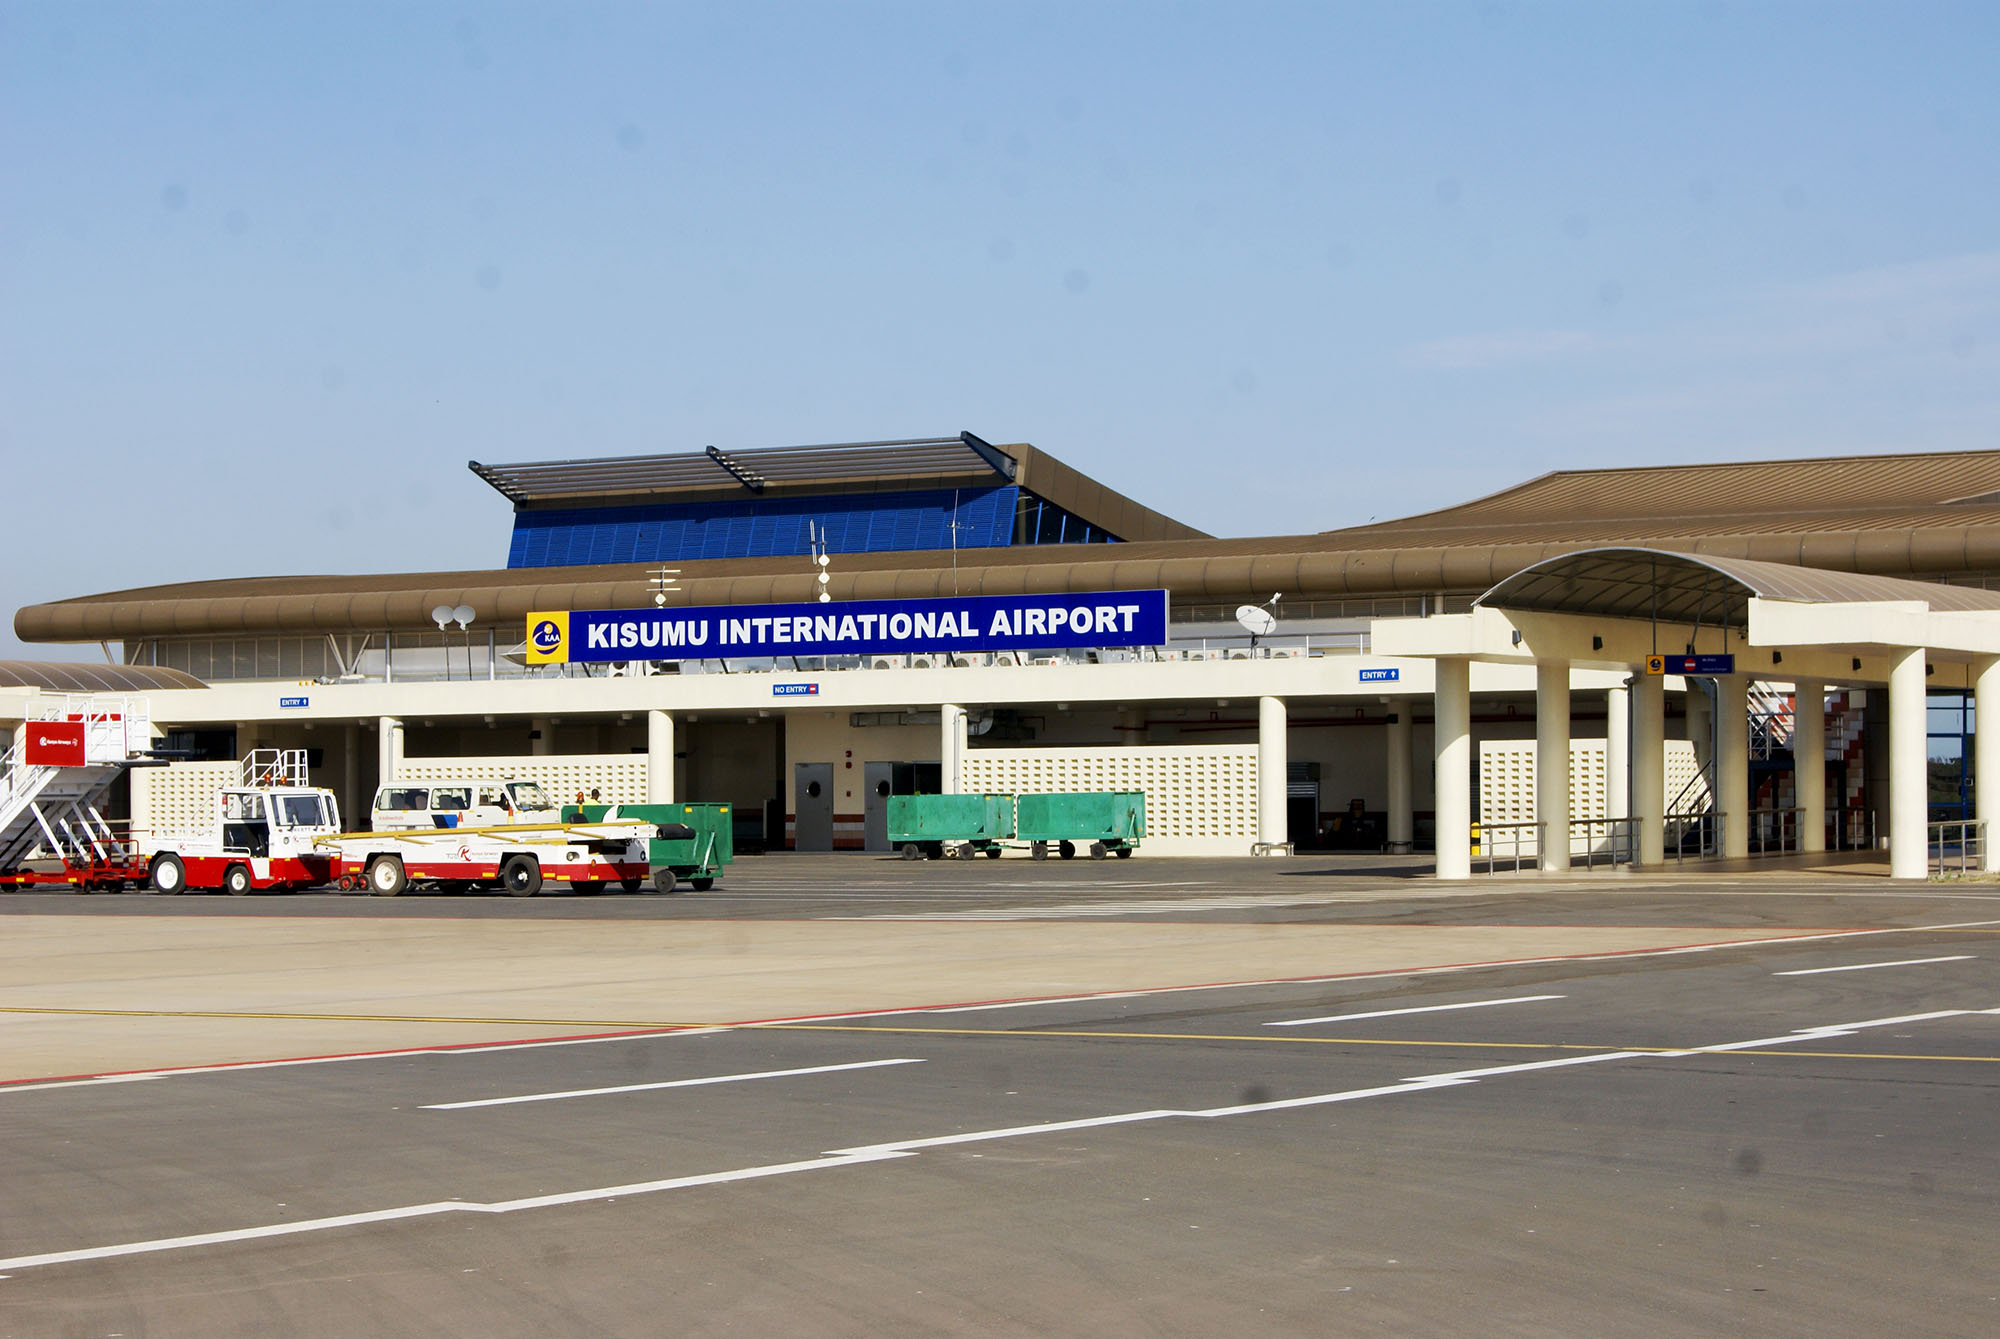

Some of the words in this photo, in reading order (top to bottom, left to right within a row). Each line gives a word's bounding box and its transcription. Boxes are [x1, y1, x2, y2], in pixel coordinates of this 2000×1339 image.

[588, 620, 709, 649] KISUMU
[719, 611, 979, 645] INTERNATIONAL
[988, 605, 1140, 636] AIRPORT
[544, 634, 560, 642] KAA
[1362, 671, 1388, 679] ENTRY
[775, 686, 785, 694] NO
